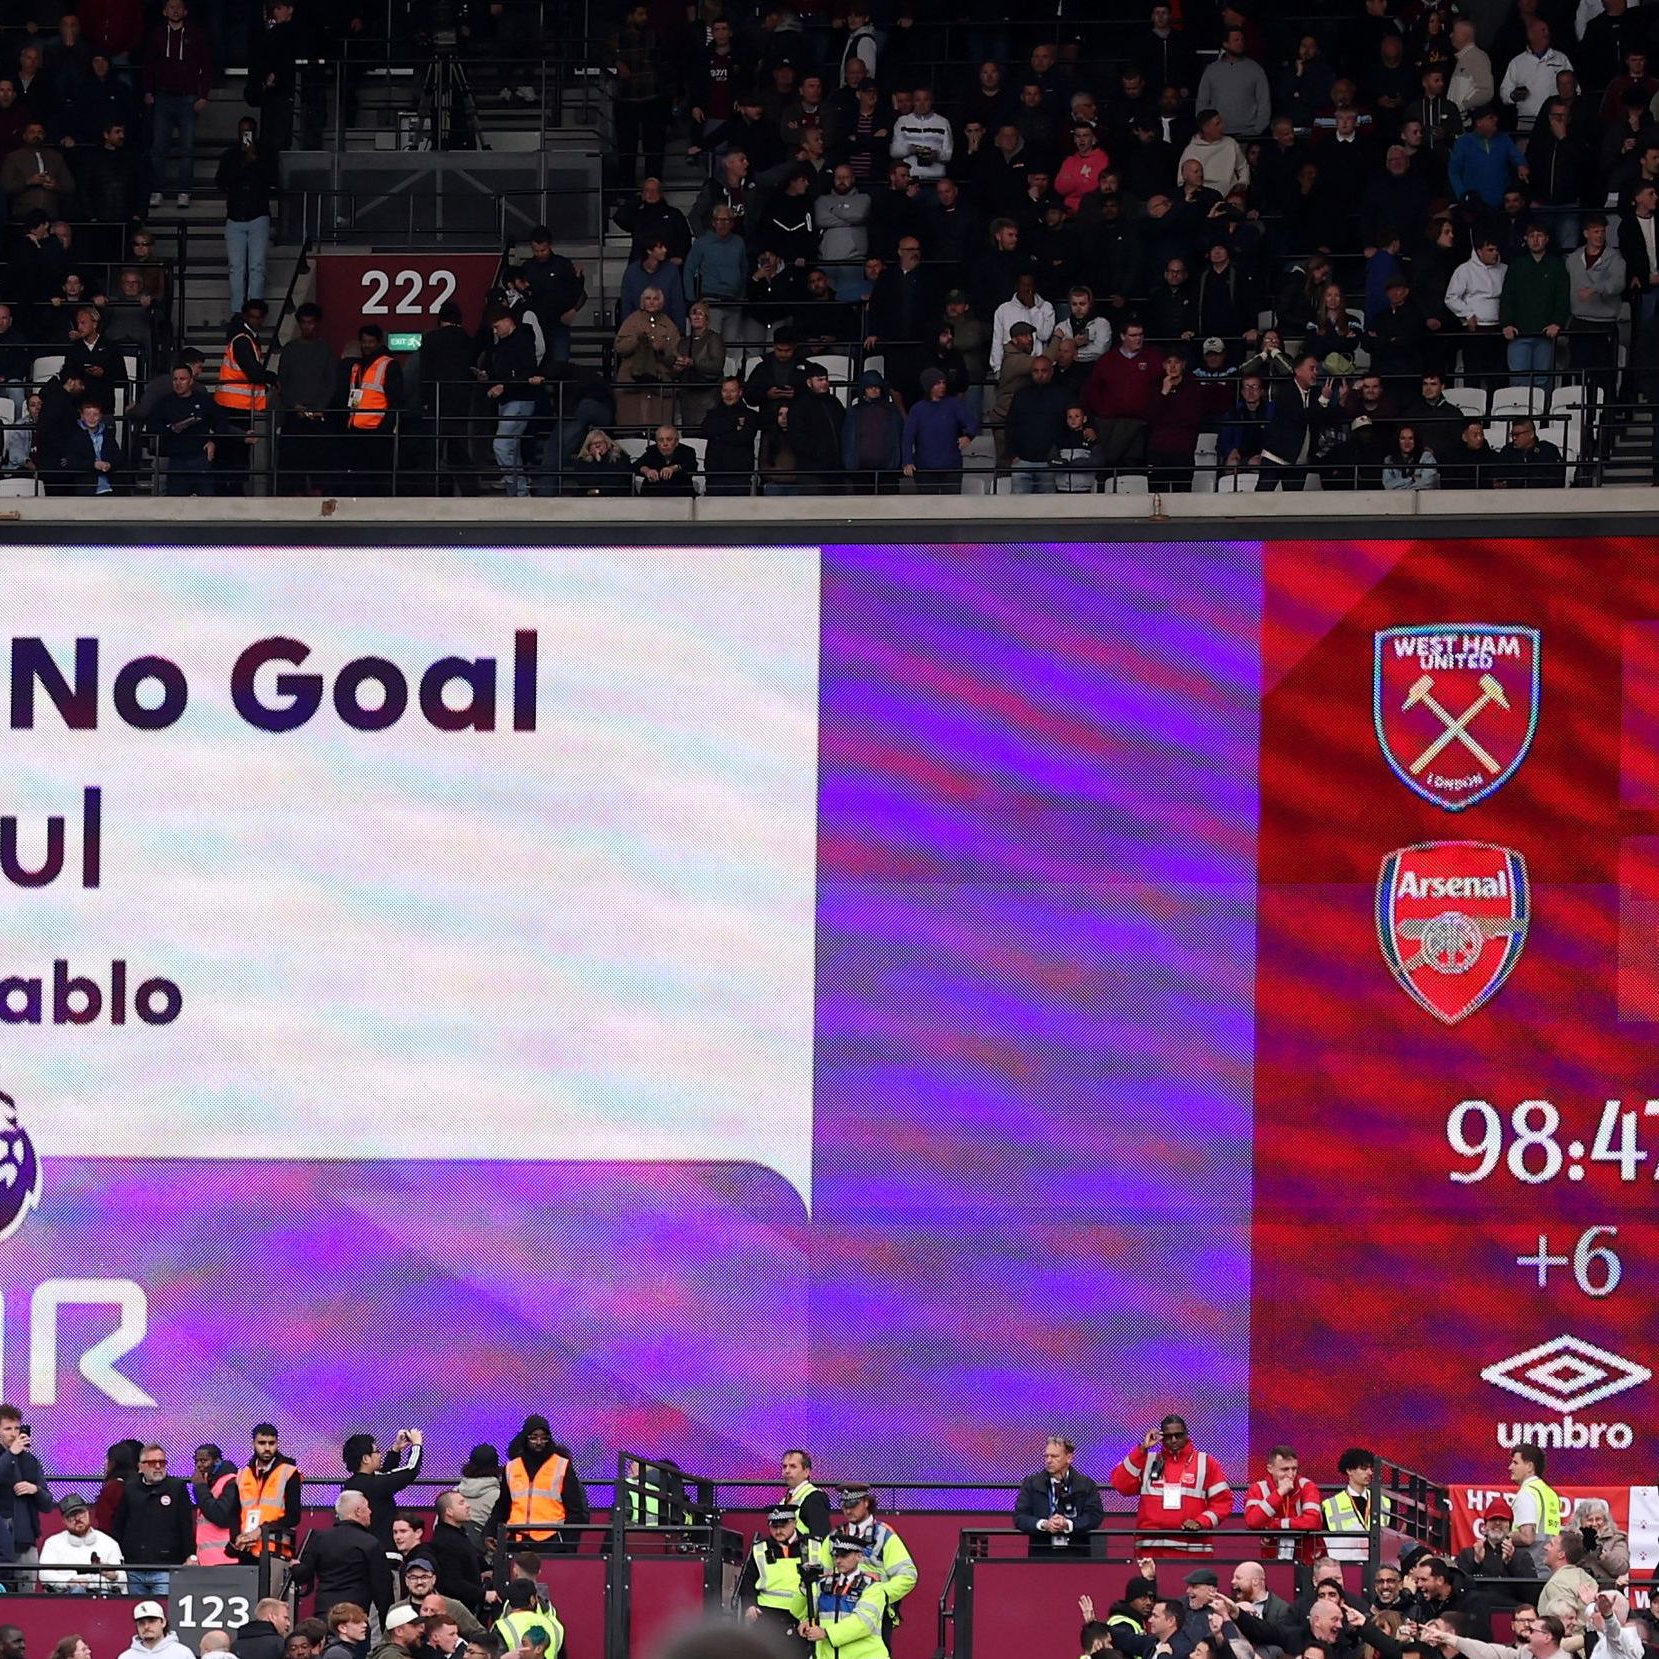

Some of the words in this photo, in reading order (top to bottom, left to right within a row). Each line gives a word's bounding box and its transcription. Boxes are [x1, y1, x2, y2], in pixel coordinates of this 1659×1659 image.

[361, 269, 457, 314] 222
[1394, 634, 1458, 660] WEST
[1461, 636, 1521, 659] HAM
[1419, 651, 1494, 670] UNITED
[10, 637, 189, 733] No
[230, 629, 538, 733] Goal
[1396, 870, 1508, 900] Arsenal
[1446, 1099, 1659, 1185] 98:4
[1516, 1225, 1622, 1298] +6
[1497, 1415, 1634, 1450] umbro
[178, 1594, 250, 1629] 123
